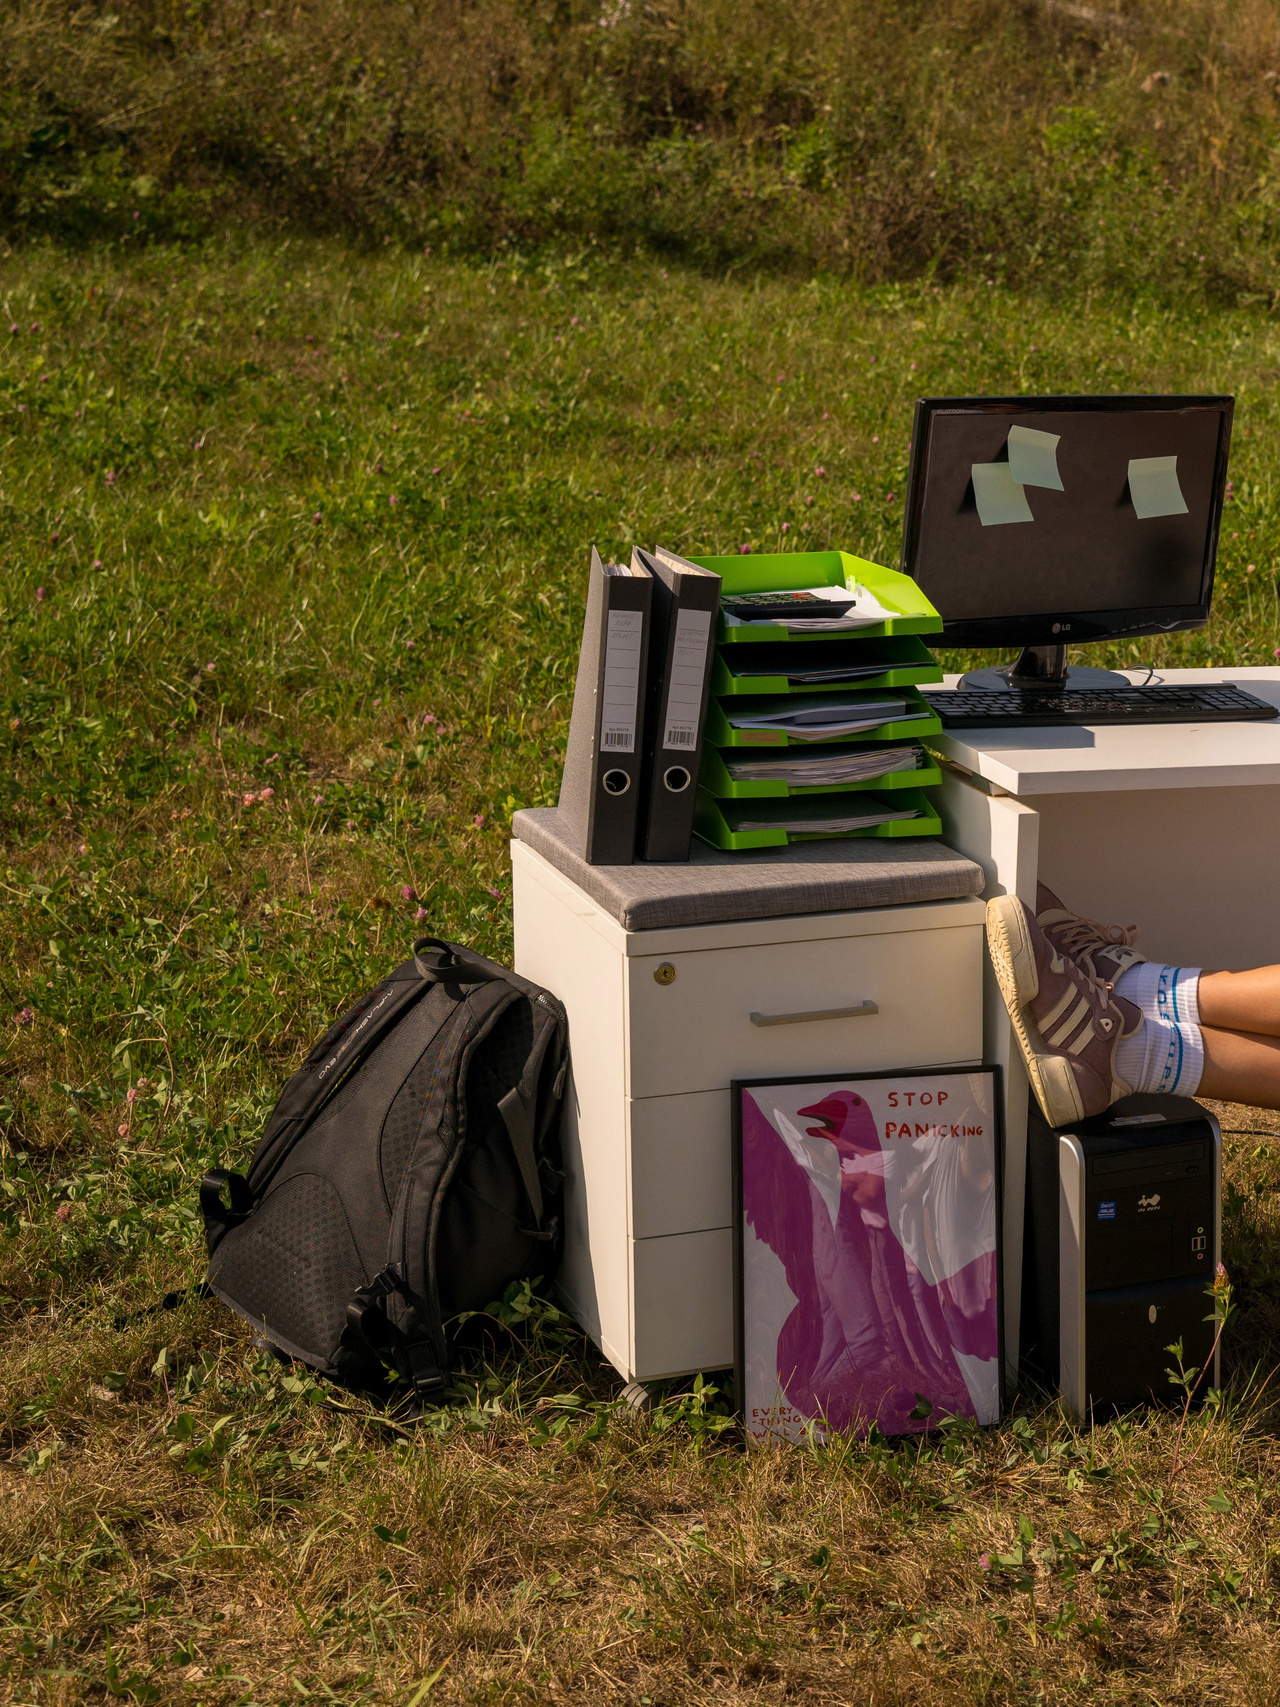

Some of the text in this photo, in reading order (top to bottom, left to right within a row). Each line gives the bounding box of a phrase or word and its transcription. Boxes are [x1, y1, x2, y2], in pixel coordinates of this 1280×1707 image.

[1061, 623, 1071, 631] LG
[887, 1091, 949, 1108] STOP
[884, 1121, 984, 1139] PANICKING
[752, 1406, 793, 1418] EVERY
